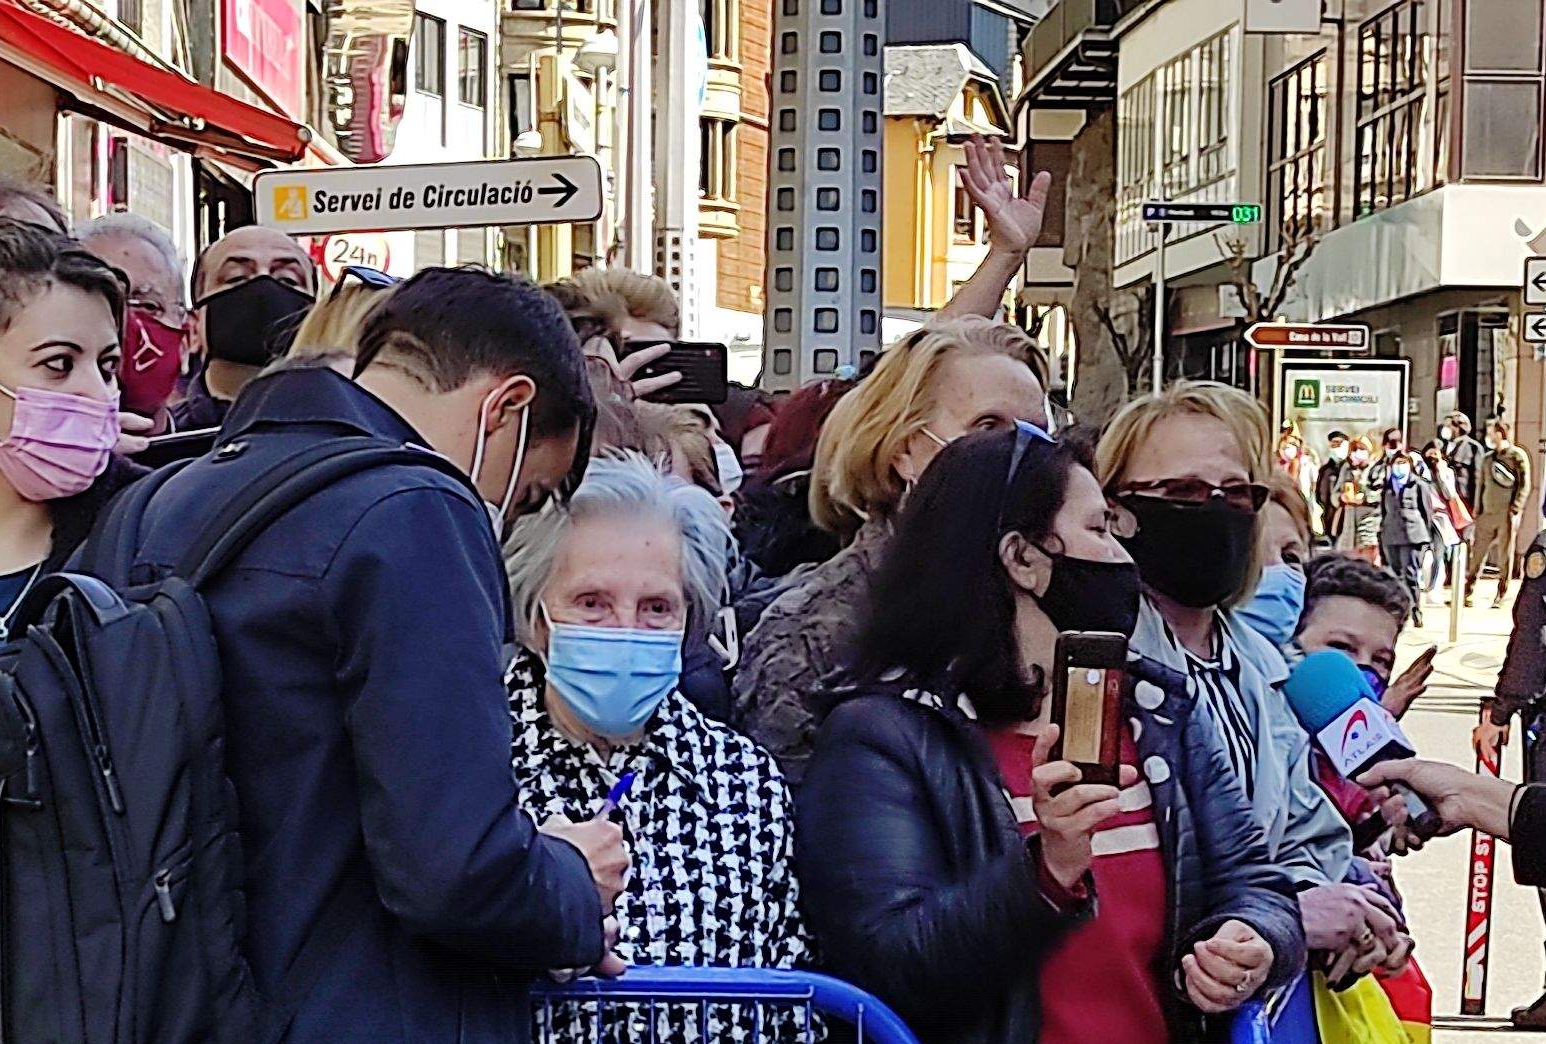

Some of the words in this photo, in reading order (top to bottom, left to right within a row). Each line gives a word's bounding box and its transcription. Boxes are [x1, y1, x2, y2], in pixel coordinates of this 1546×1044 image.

[313, 187, 381, 213] Servei
[388, 186, 415, 210] de
[423, 180, 533, 208] Circulació
[1471, 860, 1489, 913] STOP
